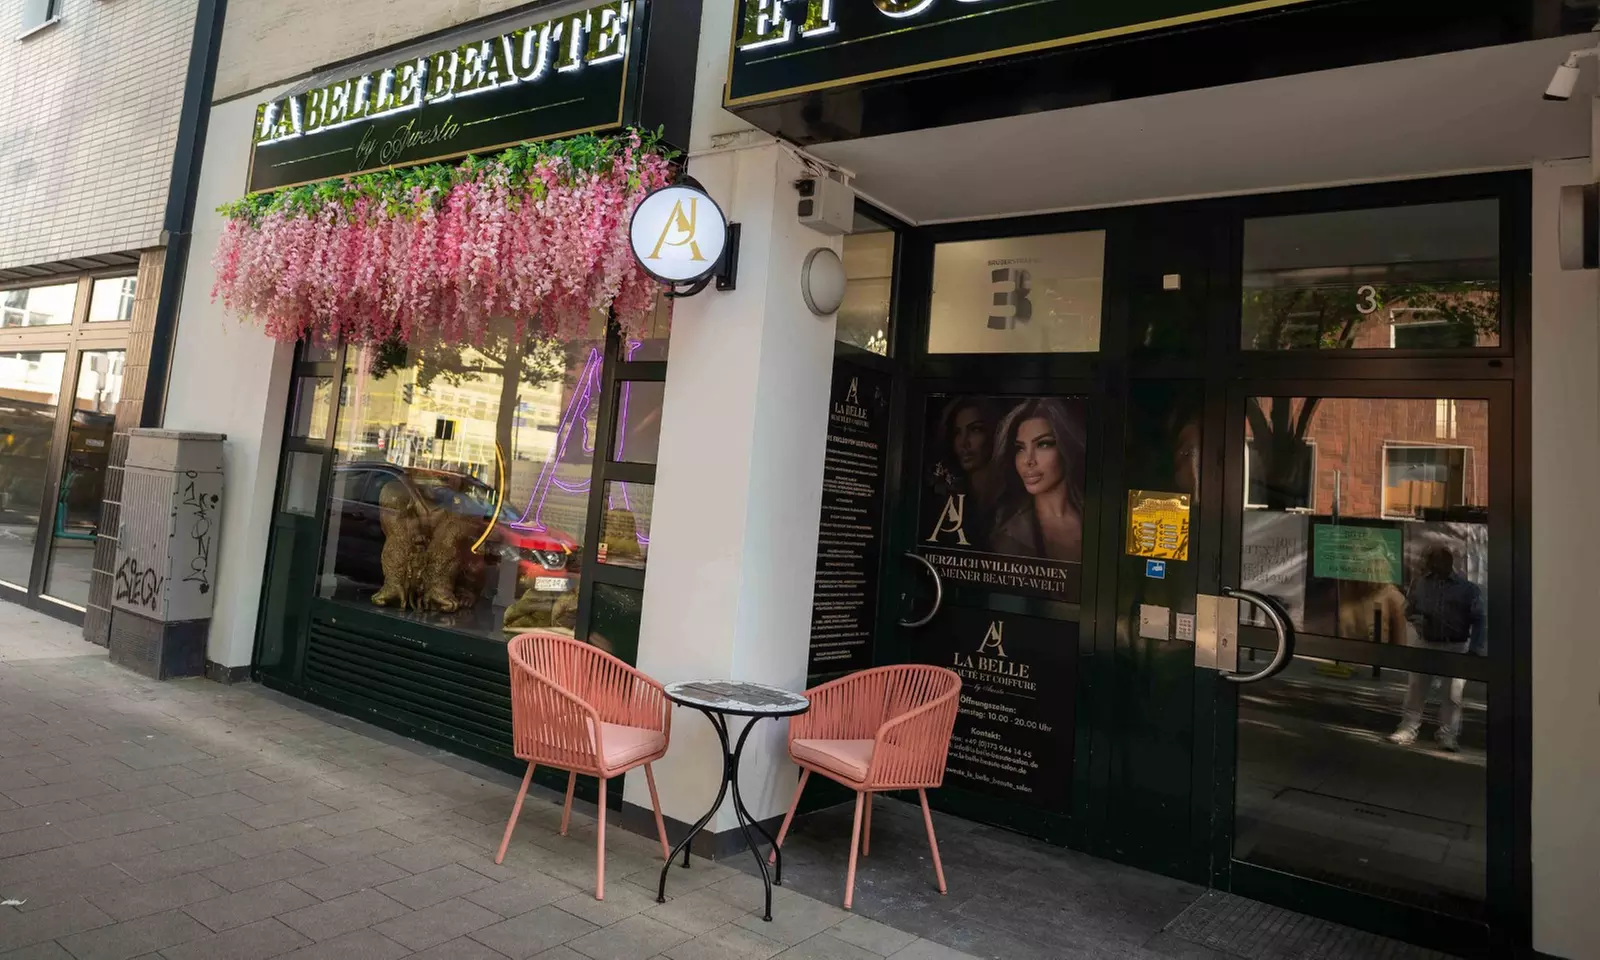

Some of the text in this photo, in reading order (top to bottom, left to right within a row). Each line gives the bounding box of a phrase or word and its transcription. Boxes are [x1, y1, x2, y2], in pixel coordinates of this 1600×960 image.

[254, 95, 304, 147] LA
[304, 57, 428, 135] BELLE
[355, 124, 379, 170] by
[1355, 284, 1377, 314] 3
[834, 401, 845, 414] LA
[925, 553, 1068, 580] HERZLICH WILLKOMMEN
[940, 567, 981, 583] MEINER
[982, 571, 1065, 592] BEAUTY-WELT!
[953, 652, 1030, 679] LA BELLE
[979, 672, 991, 682] ET
[992, 674, 1037, 691] COIFFURE
[960, 694, 1017, 715] Öffnungszeiten:
[988, 711, 1009, 724] 10.00
[1014, 717, 1037, 730] 20.00
[1038, 721, 1052, 732] Uhr
[970, 727, 1001, 741] Kontakt:
[965, 738, 977, 746] +49
[998, 744, 1012, 754] 944
[1022, 751, 1032, 759] 45
